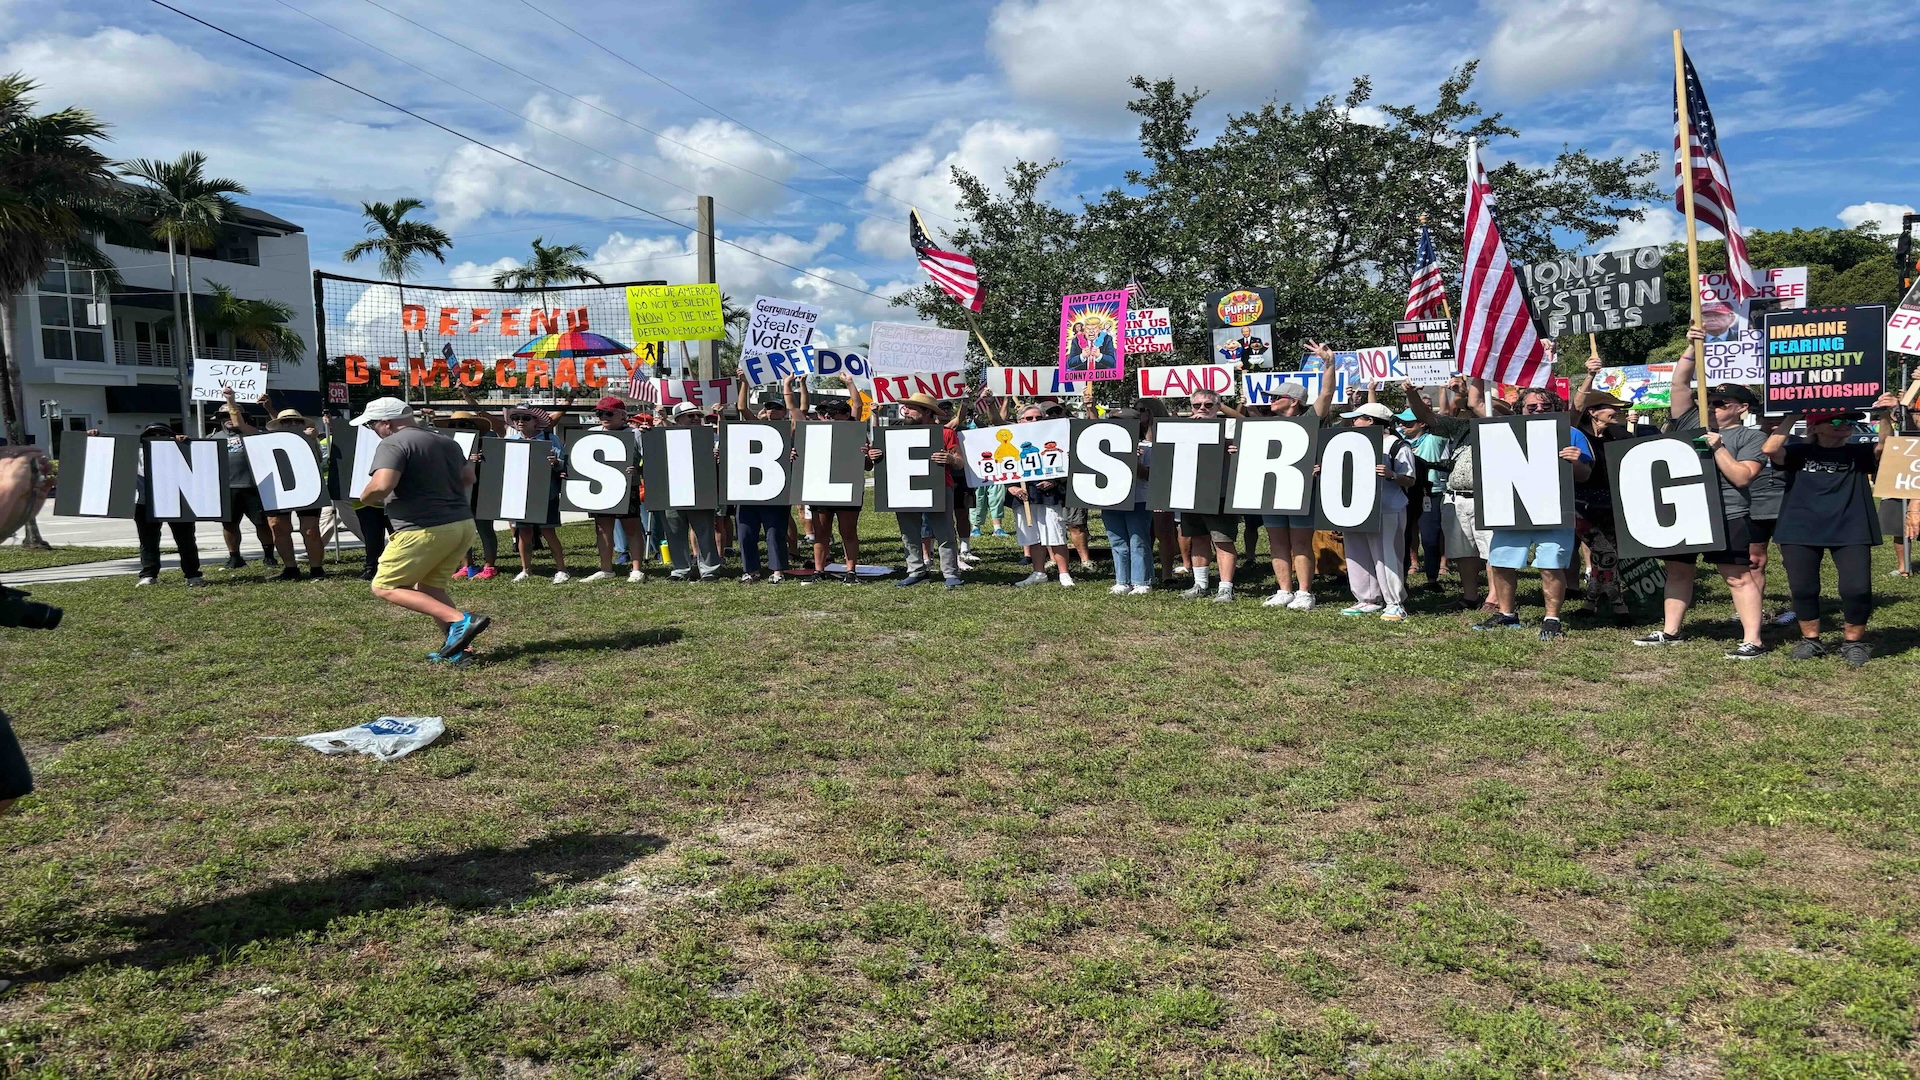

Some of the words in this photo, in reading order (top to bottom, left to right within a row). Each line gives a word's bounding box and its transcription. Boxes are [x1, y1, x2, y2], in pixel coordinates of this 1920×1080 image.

[1523, 253, 1607, 287] ONK
[1612, 246, 1661, 274] TO
[1765, 269, 1784, 282] IF
[1528, 272, 1617, 296] RELEASE
[630, 287, 661, 297] WAKE
[678, 286, 719, 297] AMERICA
[1069, 292, 1121, 304] IMPEACH
[1532, 276, 1661, 320] PSTEIN
[635, 301, 648, 310] DO
[651, 300, 668, 309] NOT
[672, 299, 683, 308] BE
[684, 298, 715, 307] SILENT
[1224, 303, 1260, 315] PUPPET
[636, 311, 663, 324] NOW
[667, 311, 676, 322] IS
[680, 310, 696, 321] THE
[697, 310, 719, 320] TIME
[756, 299, 818, 323] Gerrymandering
[1126, 311, 1136, 320] 6
[1138, 310, 1153, 319] 47
[752, 314, 799, 335] Steals
[1149, 318, 1167, 327] US
[1224, 313, 1258, 324] BABIES
[1548, 307, 1642, 338] FILES
[637, 326, 670, 337] DEFEND
[673, 325, 723, 336] DEMOCRACY
[1419, 321, 1448, 331] HATE
[1769, 321, 1847, 339] IMAGINE
[882, 326, 955, 346] IMPEACH
[1125, 336, 1154, 345] NOT
[1398, 333, 1425, 343] WON'T
[1426, 332, 1451, 341] MAKE
[879, 341, 956, 358] CONVICT
[1124, 343, 1172, 353] SCISM
[1402, 342, 1450, 351] AMERICA
[1769, 337, 1844, 355] FEARING
[879, 352, 954, 372] REMOVE
[1707, 355, 1736, 368] OF
[1769, 351, 1864, 370] DIVERSITY
[209, 364, 253, 376] STOP
[345, 354, 644, 388] DEMOCRACY
[1065, 371, 1087, 381] DONNY
[1088, 371, 1093, 380] 2
[1095, 370, 1117, 379] DOLLS
[1705, 367, 1743, 379] NITED
[1769, 371, 1805, 385] BUT
[1808, 368, 1845, 383] NOT
[218, 379, 256, 390] VOTER
[660, 378, 732, 407] LET
[873, 371, 966, 403] RING
[1004, 368, 1039, 396] IN
[1141, 366, 1232, 396] LAND
[1245, 372, 1344, 404] WITH
[1769, 382, 1880, 400] DICTATORSHIP
[329, 388, 344, 398] OR
[1072, 418, 1715, 549] STRONG
[1623, 557, 1655, 582] PROTECT
[1629, 569, 1666, 599] YOU
